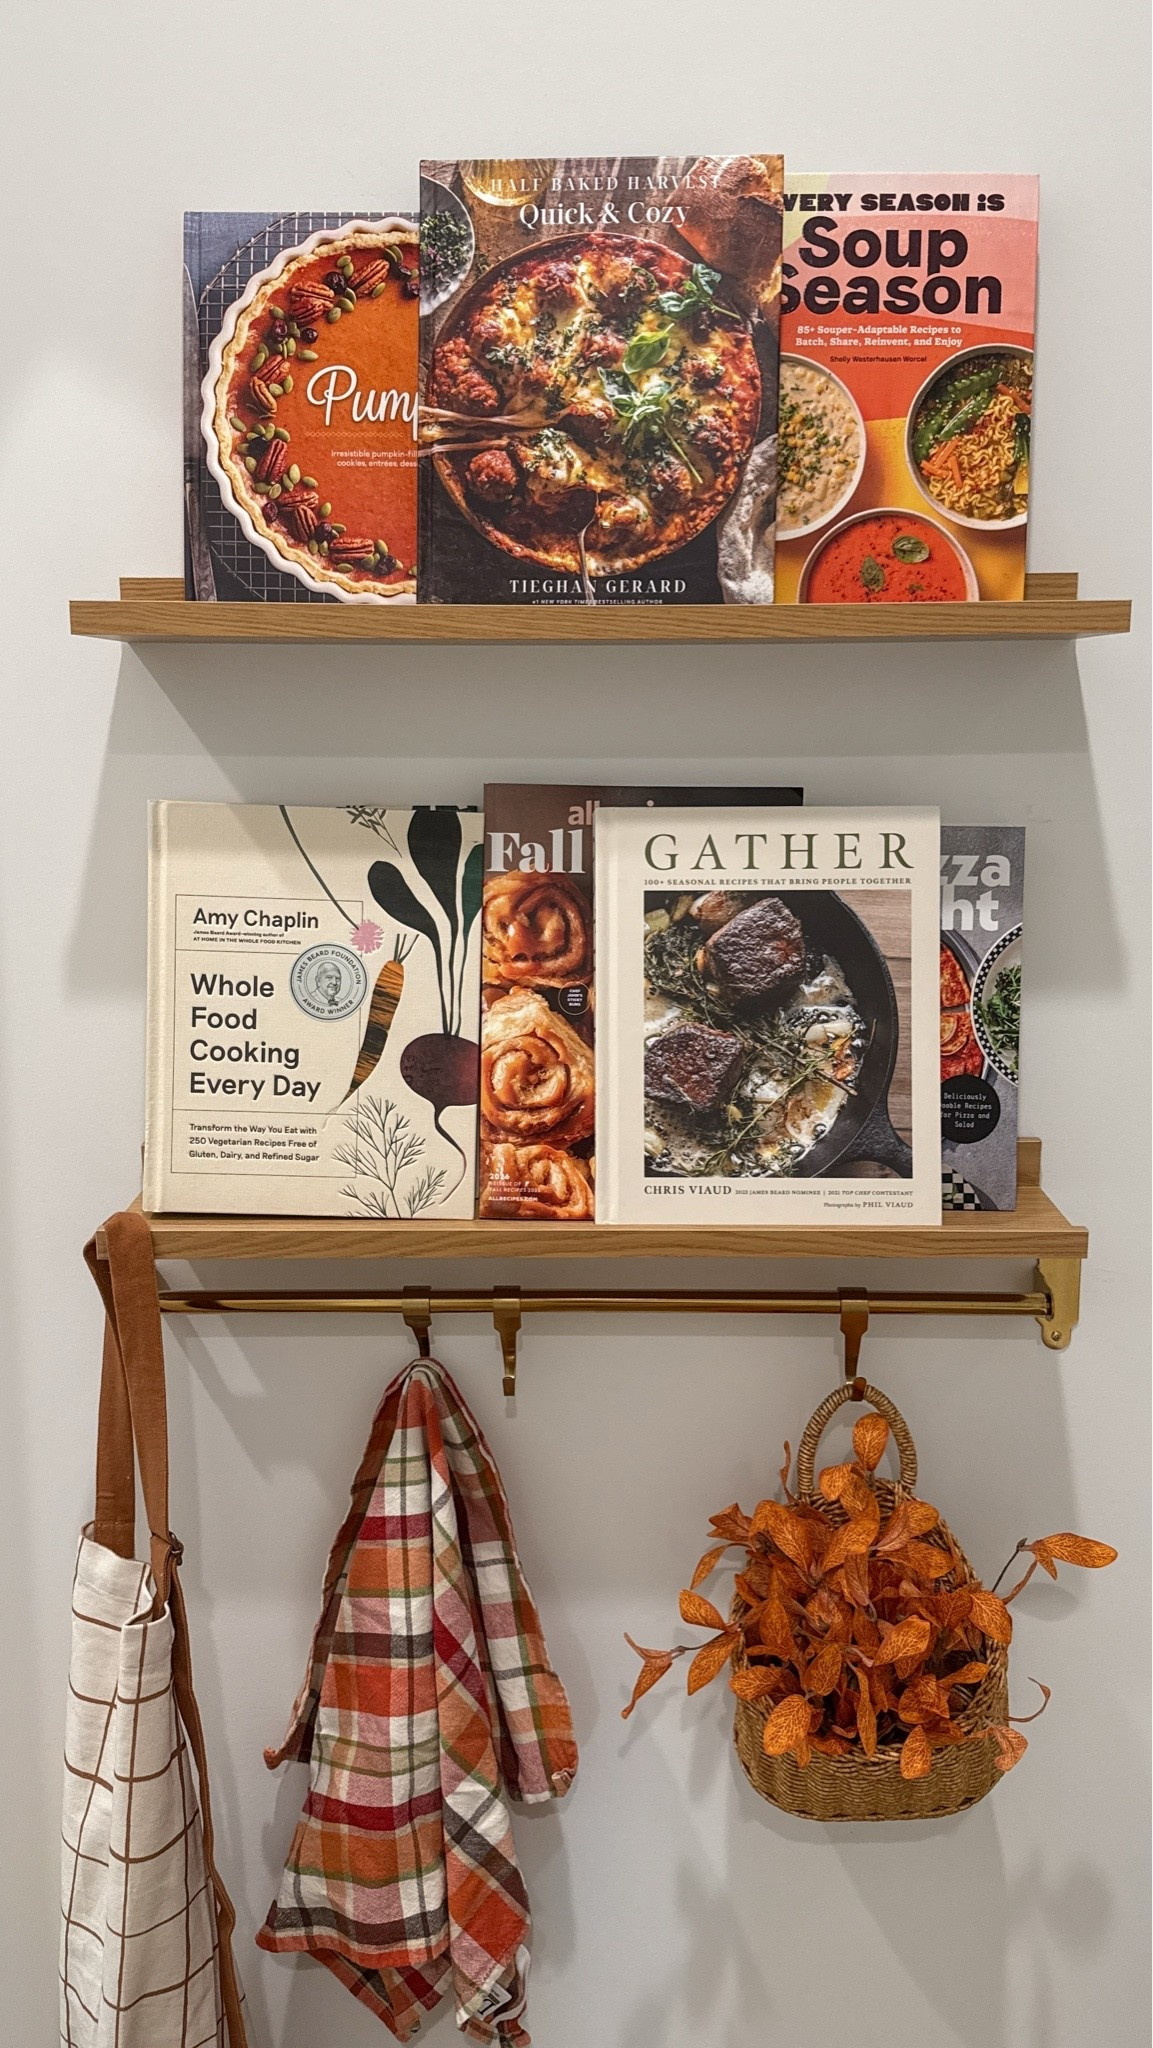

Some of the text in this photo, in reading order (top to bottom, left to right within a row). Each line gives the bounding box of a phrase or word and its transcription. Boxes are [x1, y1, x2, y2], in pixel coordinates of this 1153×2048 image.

[491, 175, 720, 191] HALF BAKED HARVEST
[783, 194, 853, 211] VERY
[861, 194, 970, 211] SEASON
[519, 202, 690, 229] Quick & Cozy
[799, 216, 968, 277] Soup
[781, 263, 1002, 315] Season
[797, 325, 961, 335] 85+ Souper-Adaptable Recipes to
[795, 338, 963, 347] Batch, Share, Reinvent, and Enjoy
[331, 449, 418, 459] Irresistible pumpkin-fill
[336, 459, 367, 467] cookies,
[400, 459, 418, 467] dess
[509, 579, 686, 593] TIEGHAN GERARD
[486, 829, 586, 874] Fall
[644, 833, 914, 870] GATHER
[789, 878, 819, 886] BRING
[941, 885, 999, 931] ht
[193, 908, 319, 932] Amy Chaplin
[296, 950, 362, 985] JAMES BEARD FOUNDATION
[190, 973, 274, 998] Whole
[302, 998, 354, 1015] AWARD WINNER
[191, 1006, 257, 1029] Food
[190, 1039, 299, 1069] Cooking
[190, 1072, 321, 1102] Every Day
[943, 1092, 987, 1101] Deliciously
[964, 1102, 992, 1110] Recipes
[955, 1111, 974, 1119] Pizza
[190, 1123, 232, 1132] Transform
[234, 1124, 248, 1133] the
[249, 1125, 266, 1134] Way
[267, 1125, 282, 1134] You
[284, 1126, 298, 1134] Eat
[954, 1120, 974, 1128] Salad
[189, 1137, 317, 1148] 250 Vegetarian Recipes Free of
[188, 1150, 319, 1162] Gluten, Dairy, and Refined Sugar
[644, 1185, 685, 1195] CHRIS
[689, 1185, 732, 1195] VIAUD
